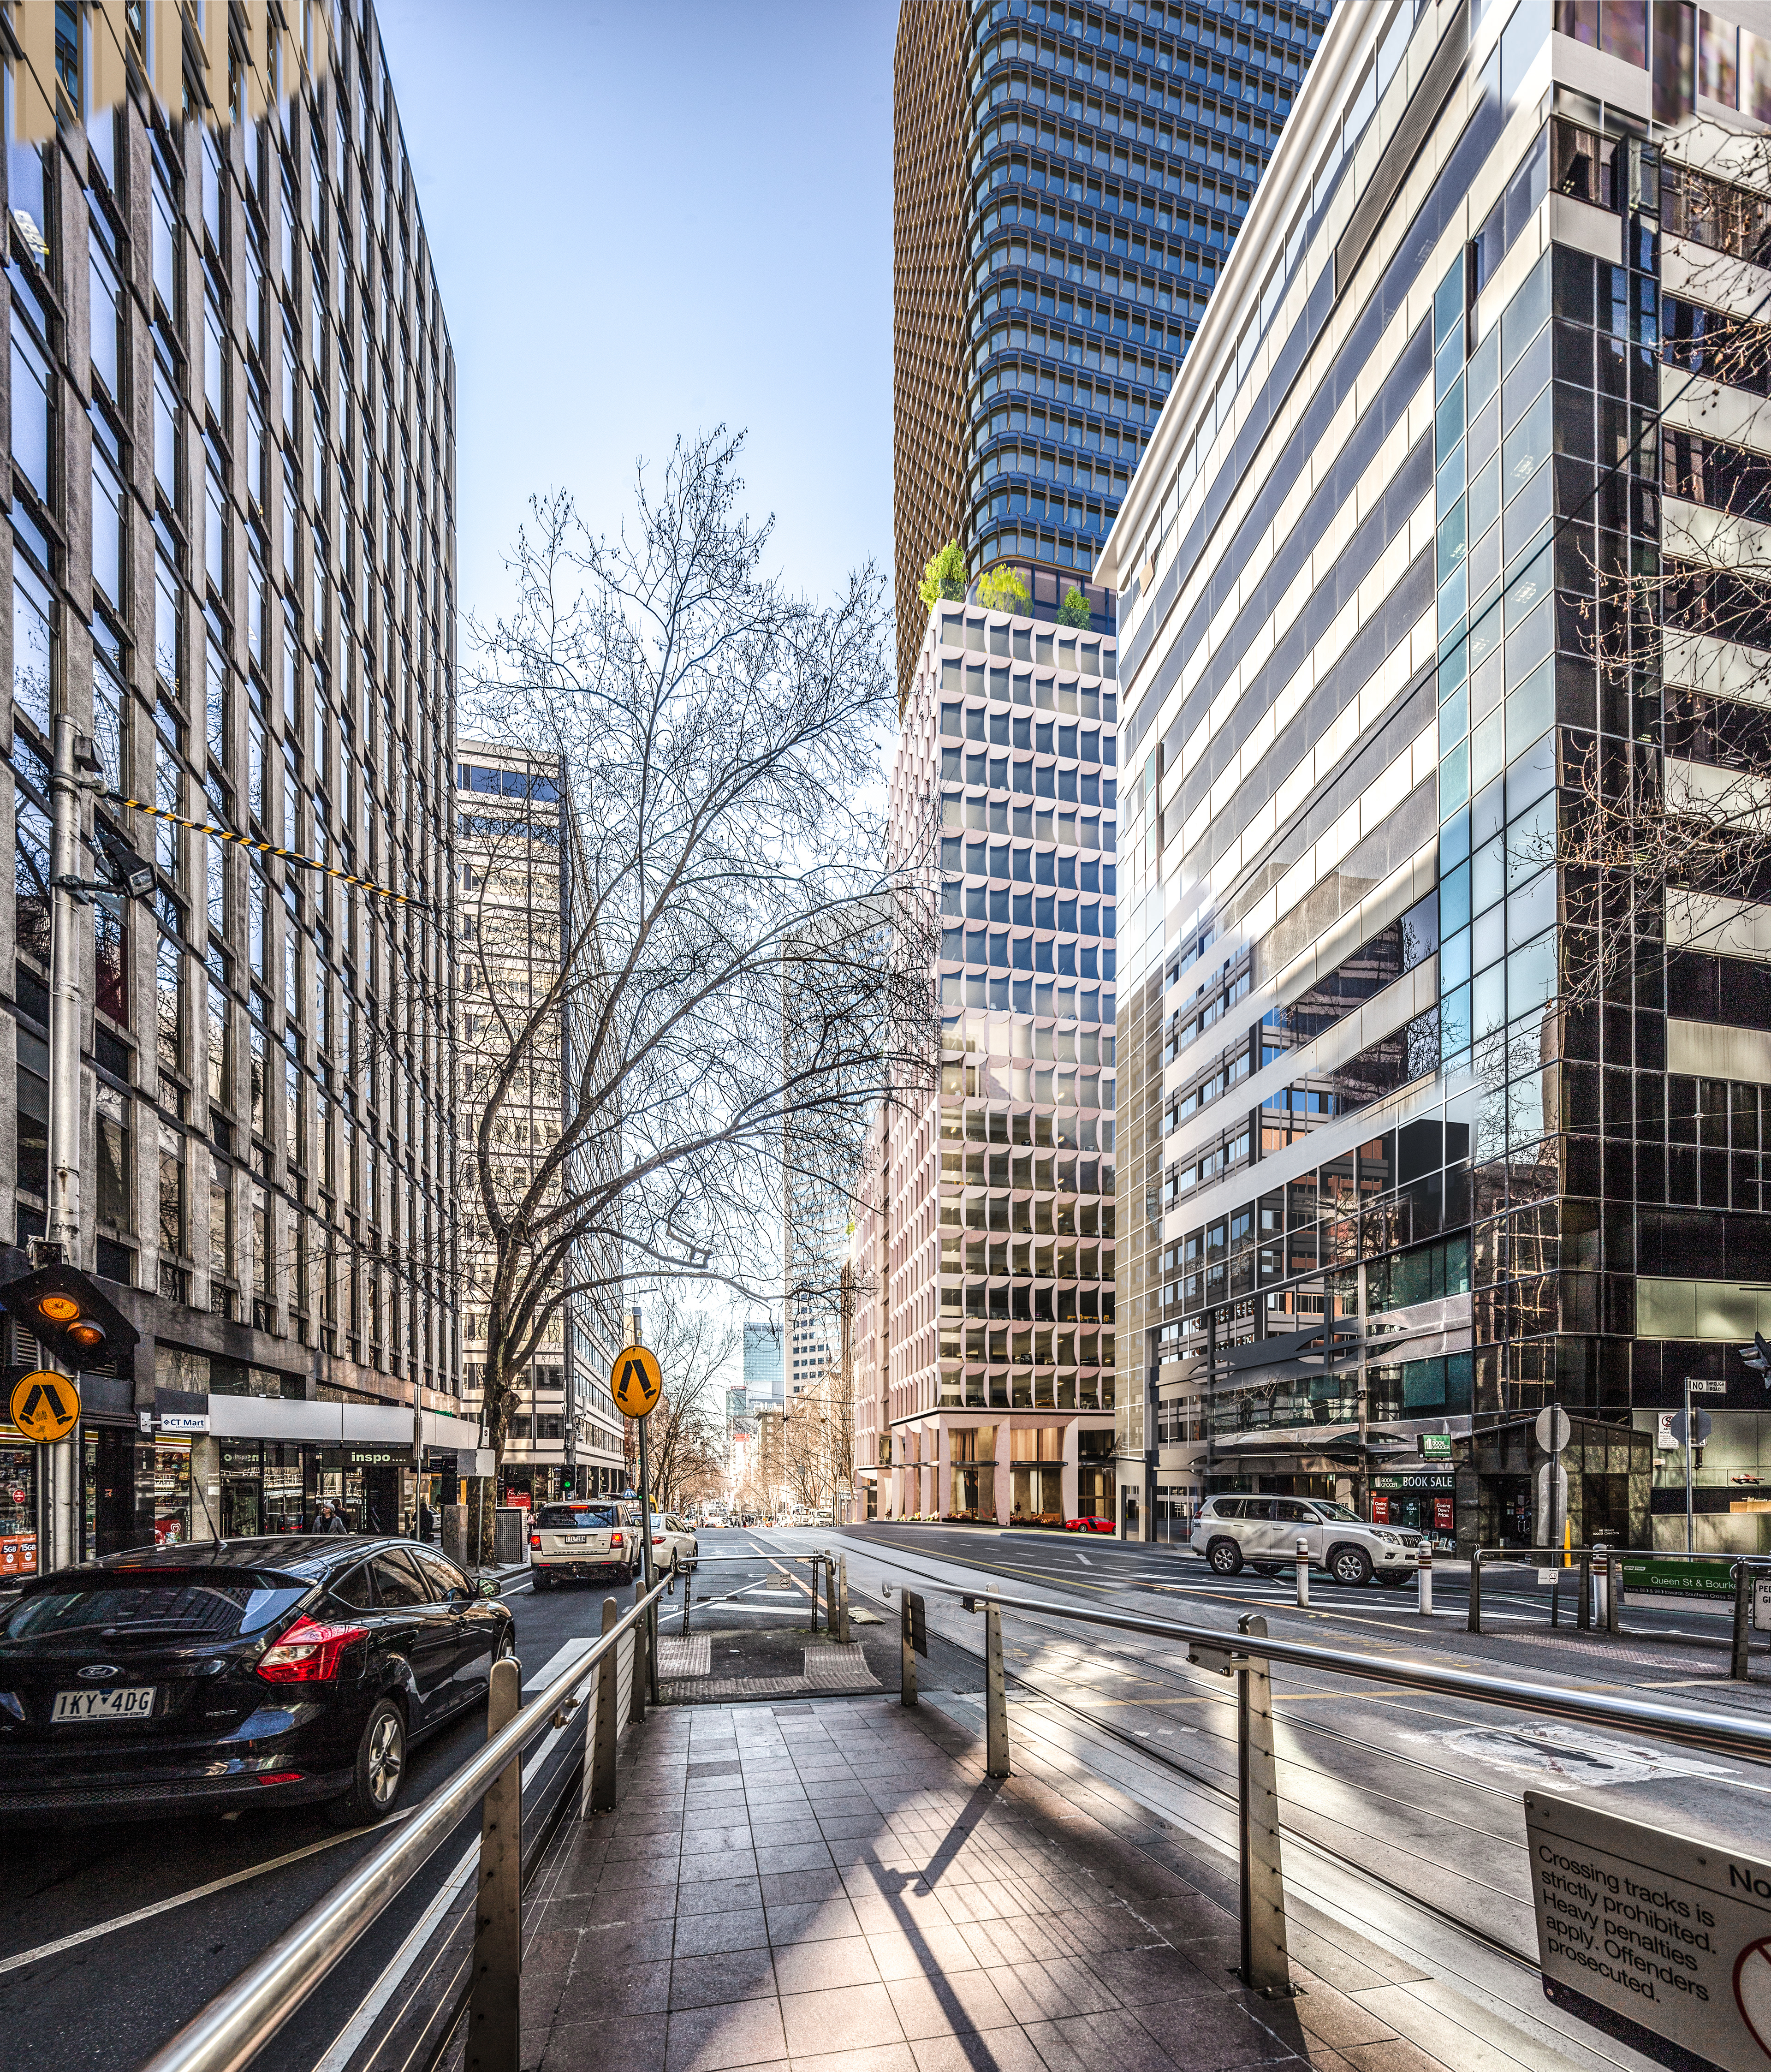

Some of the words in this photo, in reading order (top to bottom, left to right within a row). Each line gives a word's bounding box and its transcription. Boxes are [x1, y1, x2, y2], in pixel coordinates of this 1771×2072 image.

[1693, 1381, 1703, 1390] NO
[352, 1452, 390, 1464] inspo
[1403, 1477, 1428, 1487] BOOK
[1431, 1477, 1452, 1487] SALE
[1651, 1576, 1680, 1585] Queen
[1683, 1578, 1693, 1587] St
[1706, 1579, 1736, 1590] Bourke
[60, 1694, 98, 1715] 1KY
[111, 1691, 150, 1712] 4DG
[1539, 1846, 1620, 1894] Crossing
[1624, 1878, 1690, 1918] tracks
[1696, 1903, 1715, 1928] is
[1729, 1864, 1771, 1899] No
[1541, 1870, 1598, 1907] strictly
[1603, 1896, 1717, 1954] prohibited.
[1543, 1889, 1599, 1930] Heavy
[1604, 1919, 1698, 1971] penalties
[1546, 1915, 1599, 1950] apply.
[1604, 1939, 1709, 2001] Offenders
[1548, 1937, 1661, 2004] prosecuted.
